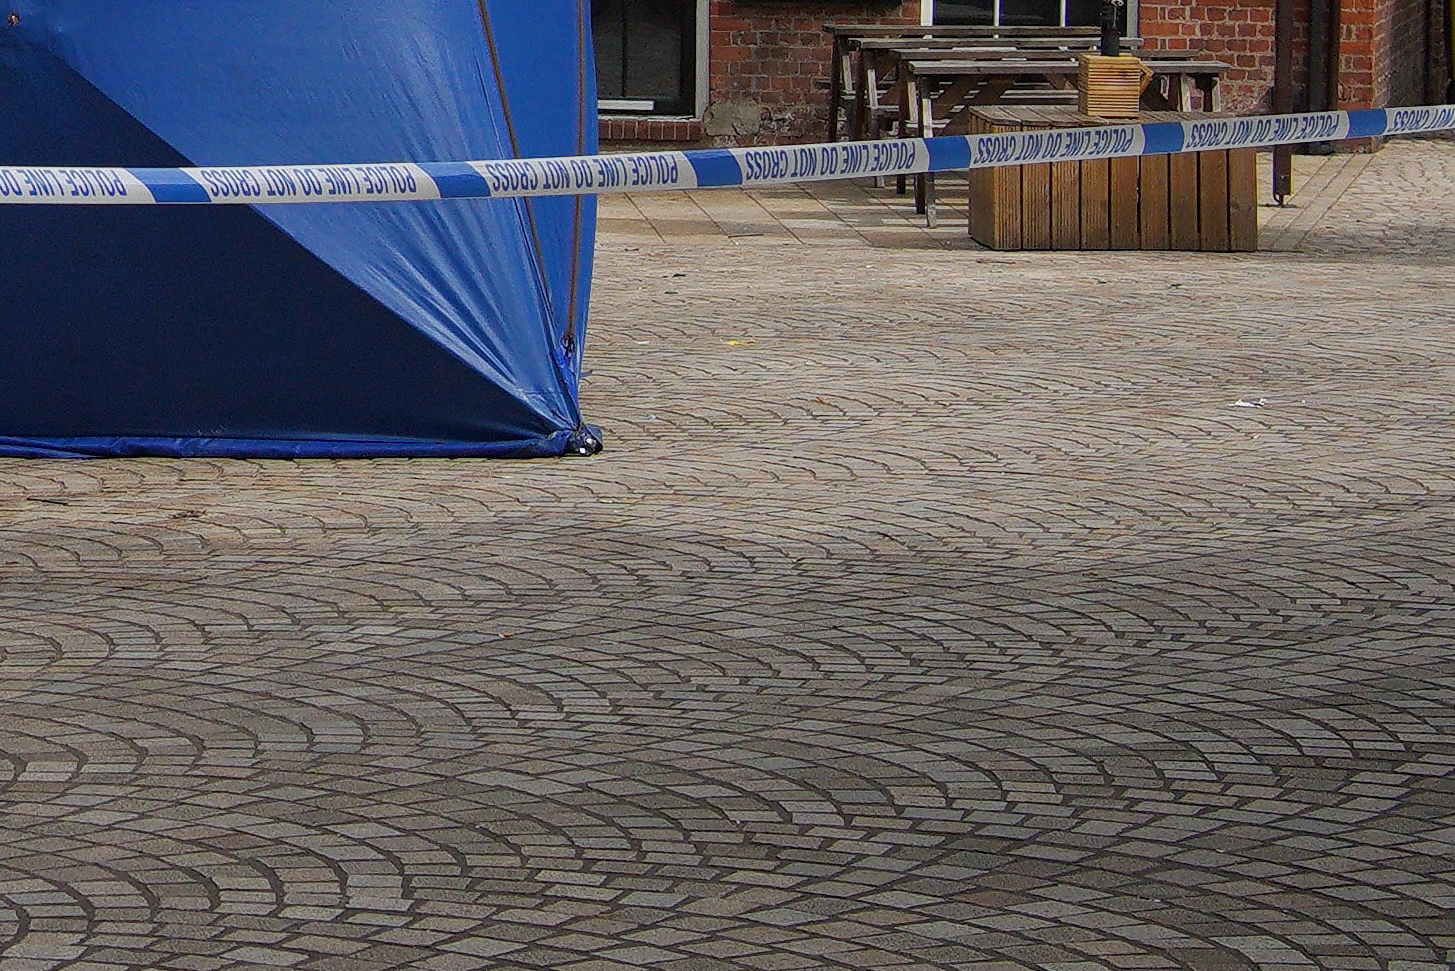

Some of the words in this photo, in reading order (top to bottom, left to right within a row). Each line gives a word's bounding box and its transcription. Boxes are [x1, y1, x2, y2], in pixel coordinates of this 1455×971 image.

[1225, 120, 1253, 145] NOT
[1250, 119, 1272, 143] DO
[1268, 117, 1298, 141] LINE
[1296, 114, 1339, 139] POLICE
[1387, 110, 1430, 133] CROSS
[1423, 109, 1454, 130] NOT
[1014, 134, 1043, 161] NOT
[1041, 133, 1063, 159] DO
[1059, 130, 1091, 157] LINE
[1088, 128, 1134, 155] POLICE
[1186, 122, 1227, 148] CROSS
[790, 148, 817, 178] NOT
[820, 147, 838, 176] DO
[840, 144, 869, 173] LINE
[870, 141, 916, 172] POLICE
[973, 136, 1016, 164] CROSS
[485, 162, 538, 192] CROSS
[540, 160, 570, 190] NOT
[570, 159, 593, 188] DO
[593, 157, 627, 188] LINE
[627, 155, 678, 185] POLICE
[745, 150, 788, 180] CROSS
[17, 168, 65, 196] LINE
[59, 169, 127, 197] POLICE
[201, 169, 261, 197] CROSS
[259, 168, 296, 196] NOT
[295, 168, 322, 196] DO
[319, 167, 361, 195] LINE
[357, 166, 416, 194] POLICE
